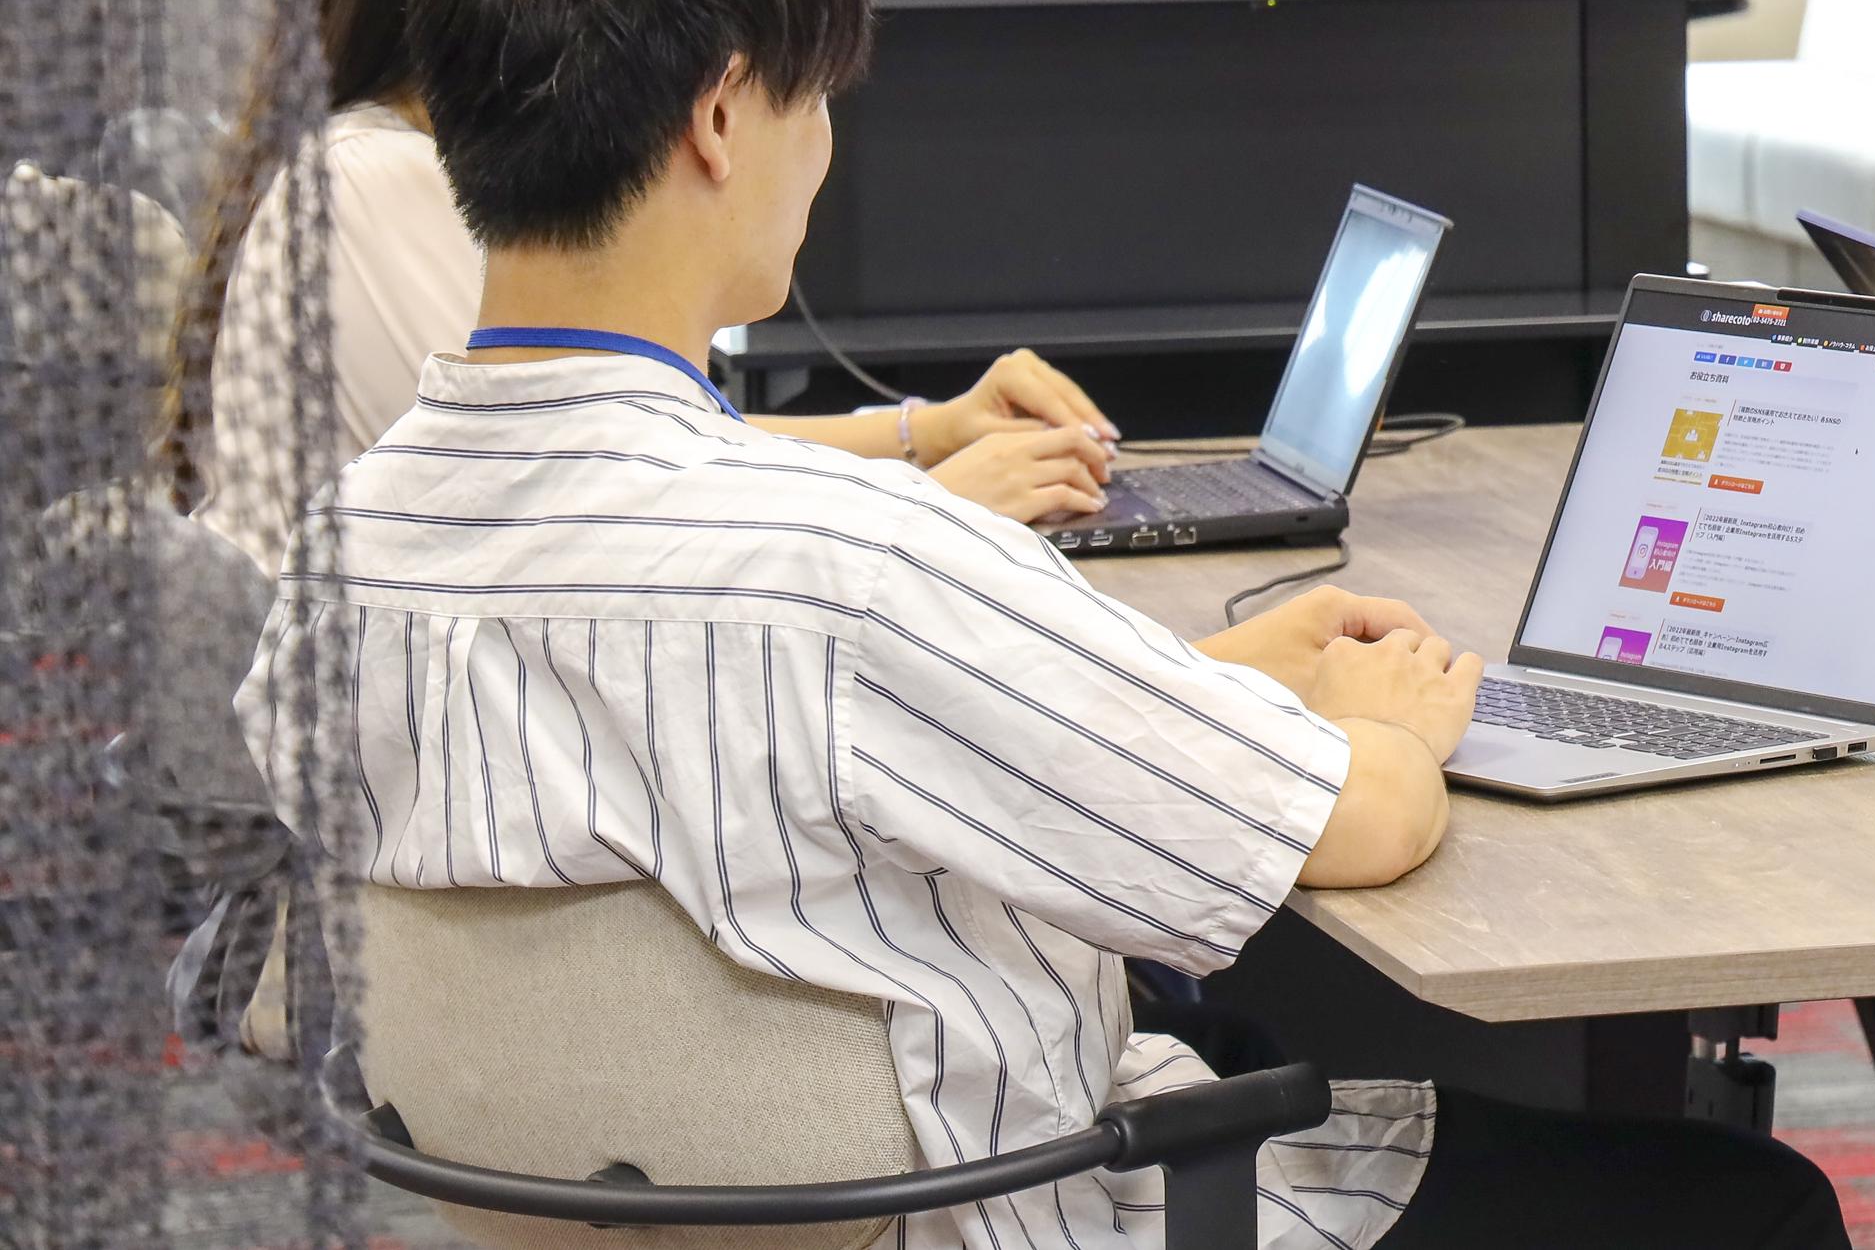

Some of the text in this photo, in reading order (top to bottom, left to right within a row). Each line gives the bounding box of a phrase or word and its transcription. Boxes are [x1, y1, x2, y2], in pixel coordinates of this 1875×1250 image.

[1711, 312, 1751, 326] sharecoto
[1689, 371, 1729, 384] お役立ち資料
[1648, 558, 1674, 573] 入門編
